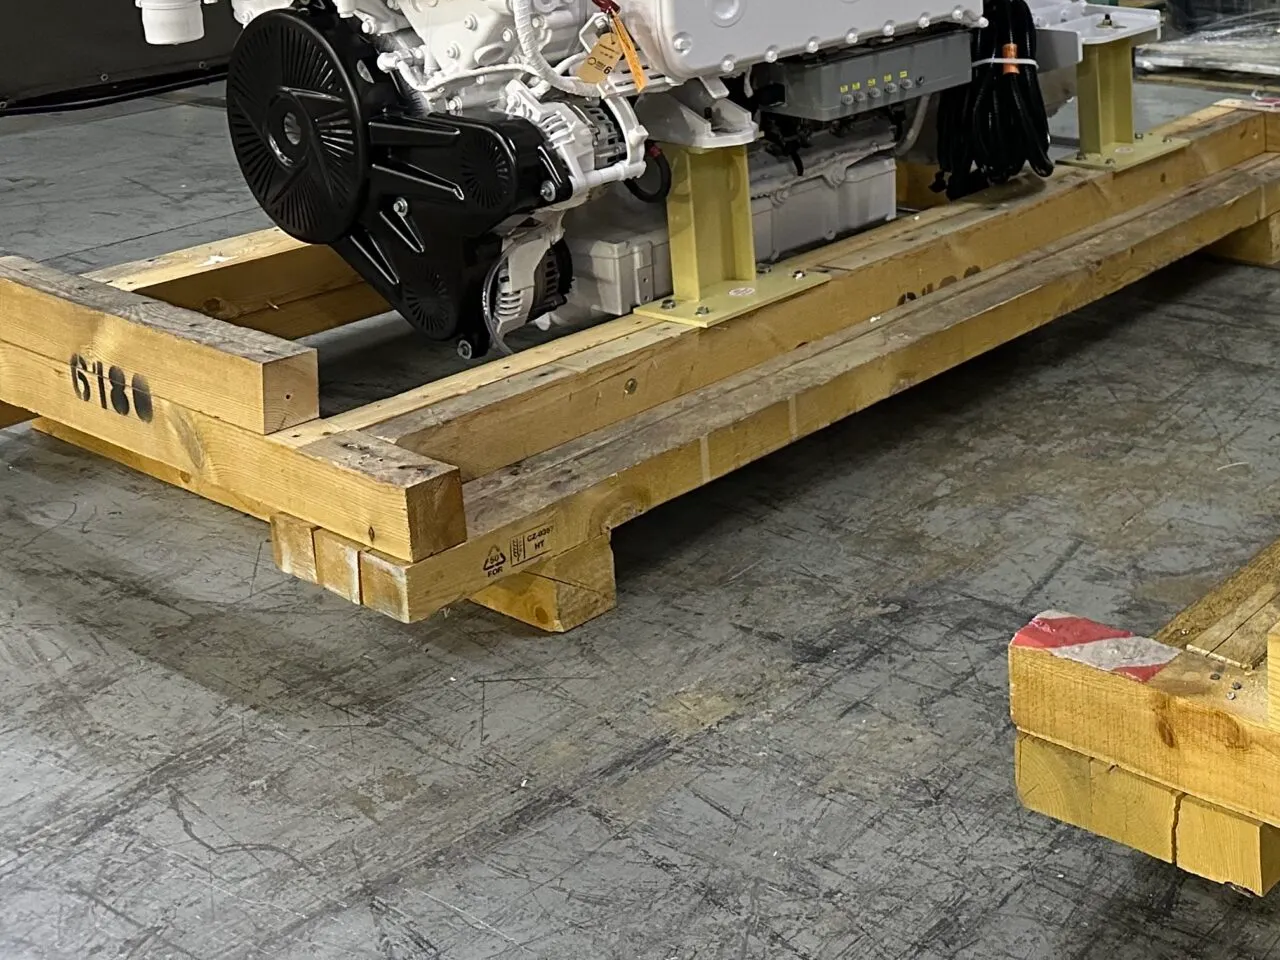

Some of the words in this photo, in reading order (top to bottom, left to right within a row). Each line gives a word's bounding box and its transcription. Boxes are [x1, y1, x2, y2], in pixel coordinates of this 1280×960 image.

[70, 352, 154, 425] 6180
[534, 539, 545, 550] HT
[487, 565, 504, 578] FOR
